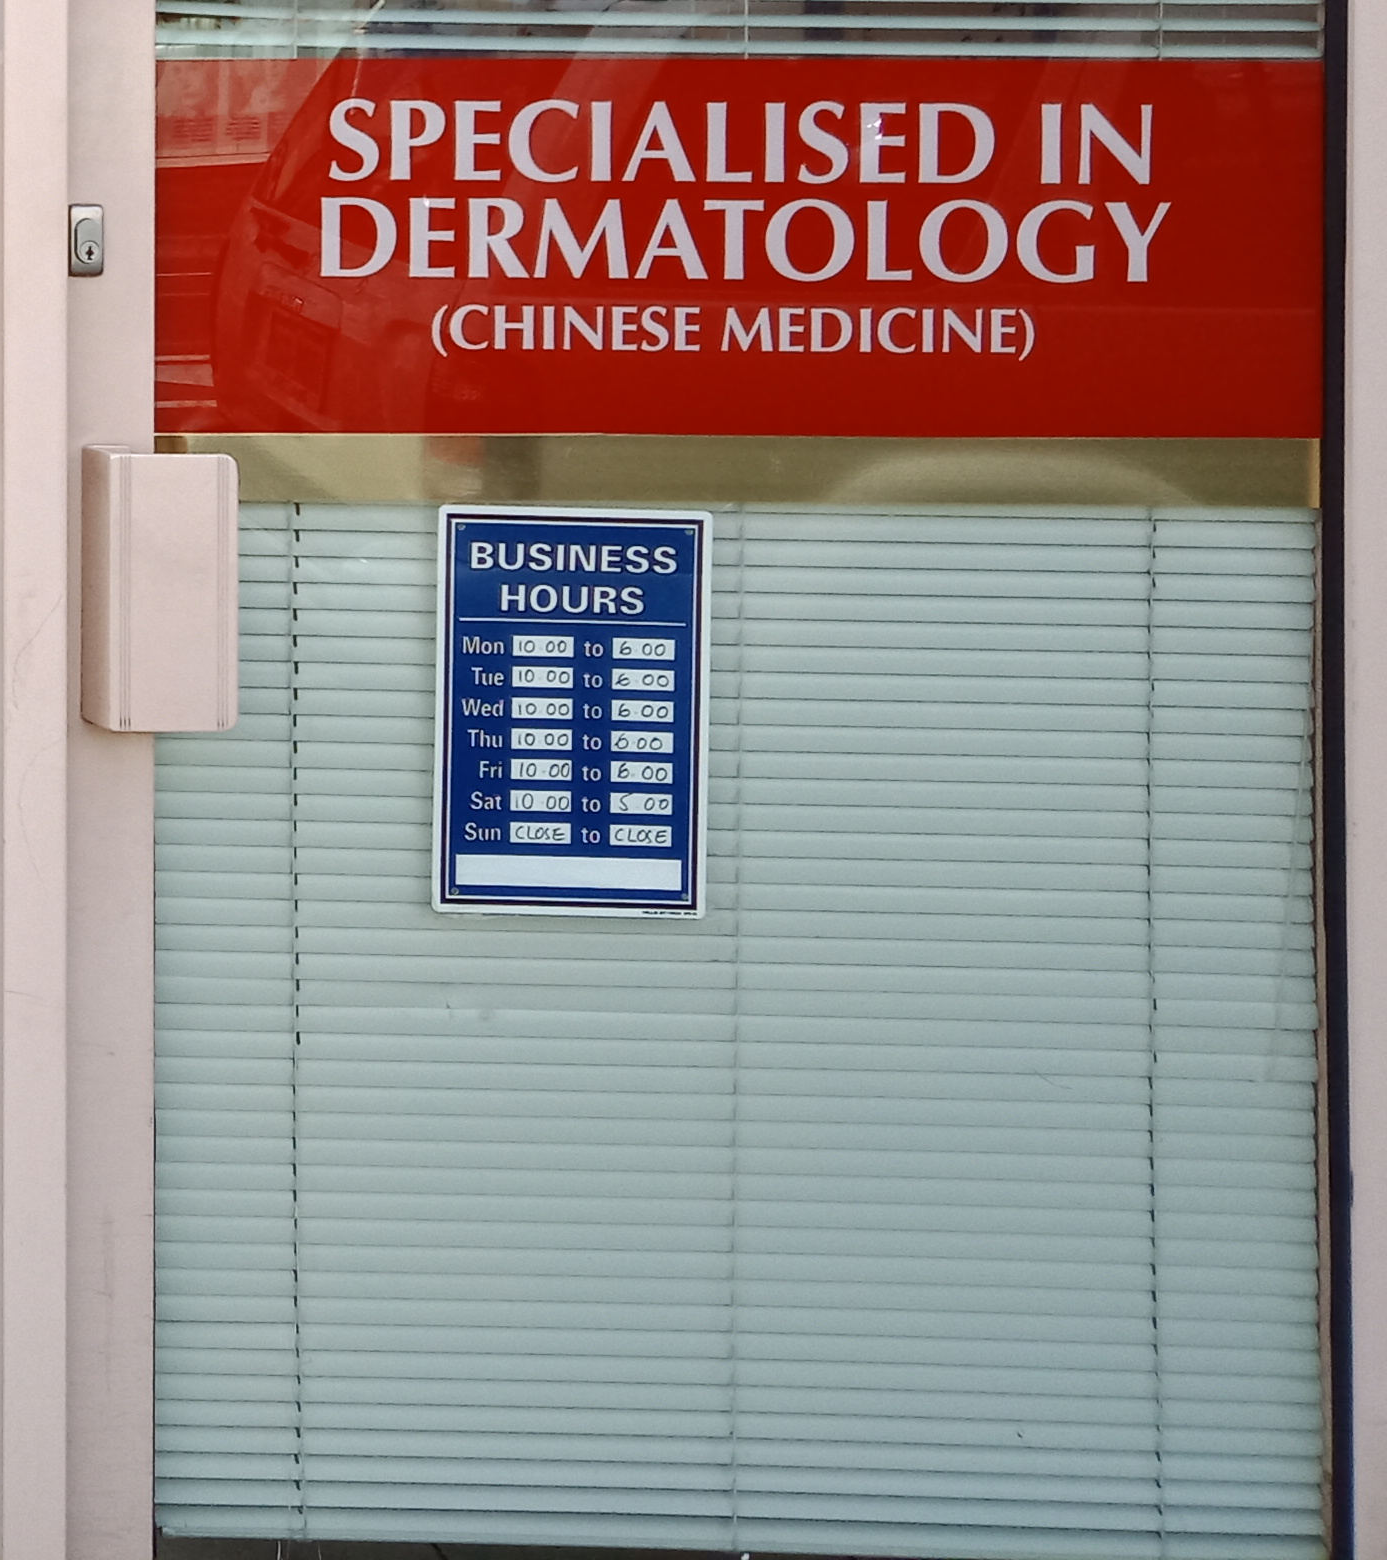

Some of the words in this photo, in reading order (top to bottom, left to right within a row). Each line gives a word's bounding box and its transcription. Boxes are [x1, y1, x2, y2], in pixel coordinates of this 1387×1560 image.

[328, 97, 995, 185] SPECIALISED
[1038, 101, 1154, 186] IN
[318, 195, 1172, 287] DERMATOLOGY
[430, 303, 701, 360] (CHINESE
[718, 303, 1036, 362] MEDICINE)
[469, 541, 679, 575] BUSINESS
[499, 584, 645, 616] HOURS
[462, 635, 505, 654] Mon
[584, 640, 604, 657] to
[471, 666, 505, 687] Tue
[583, 672, 604, 689] to
[461, 698, 505, 718] Wed
[583, 703, 603, 720] to
[467, 728, 503, 749] Thu
[582, 733, 603, 750] to
[479, 760, 503, 779] Fri
[581, 765, 602, 782] to
[470, 791, 503, 811] Sat
[581, 795, 602, 813] to
[464, 822, 502, 842] Sun
[580, 827, 601, 844] to
